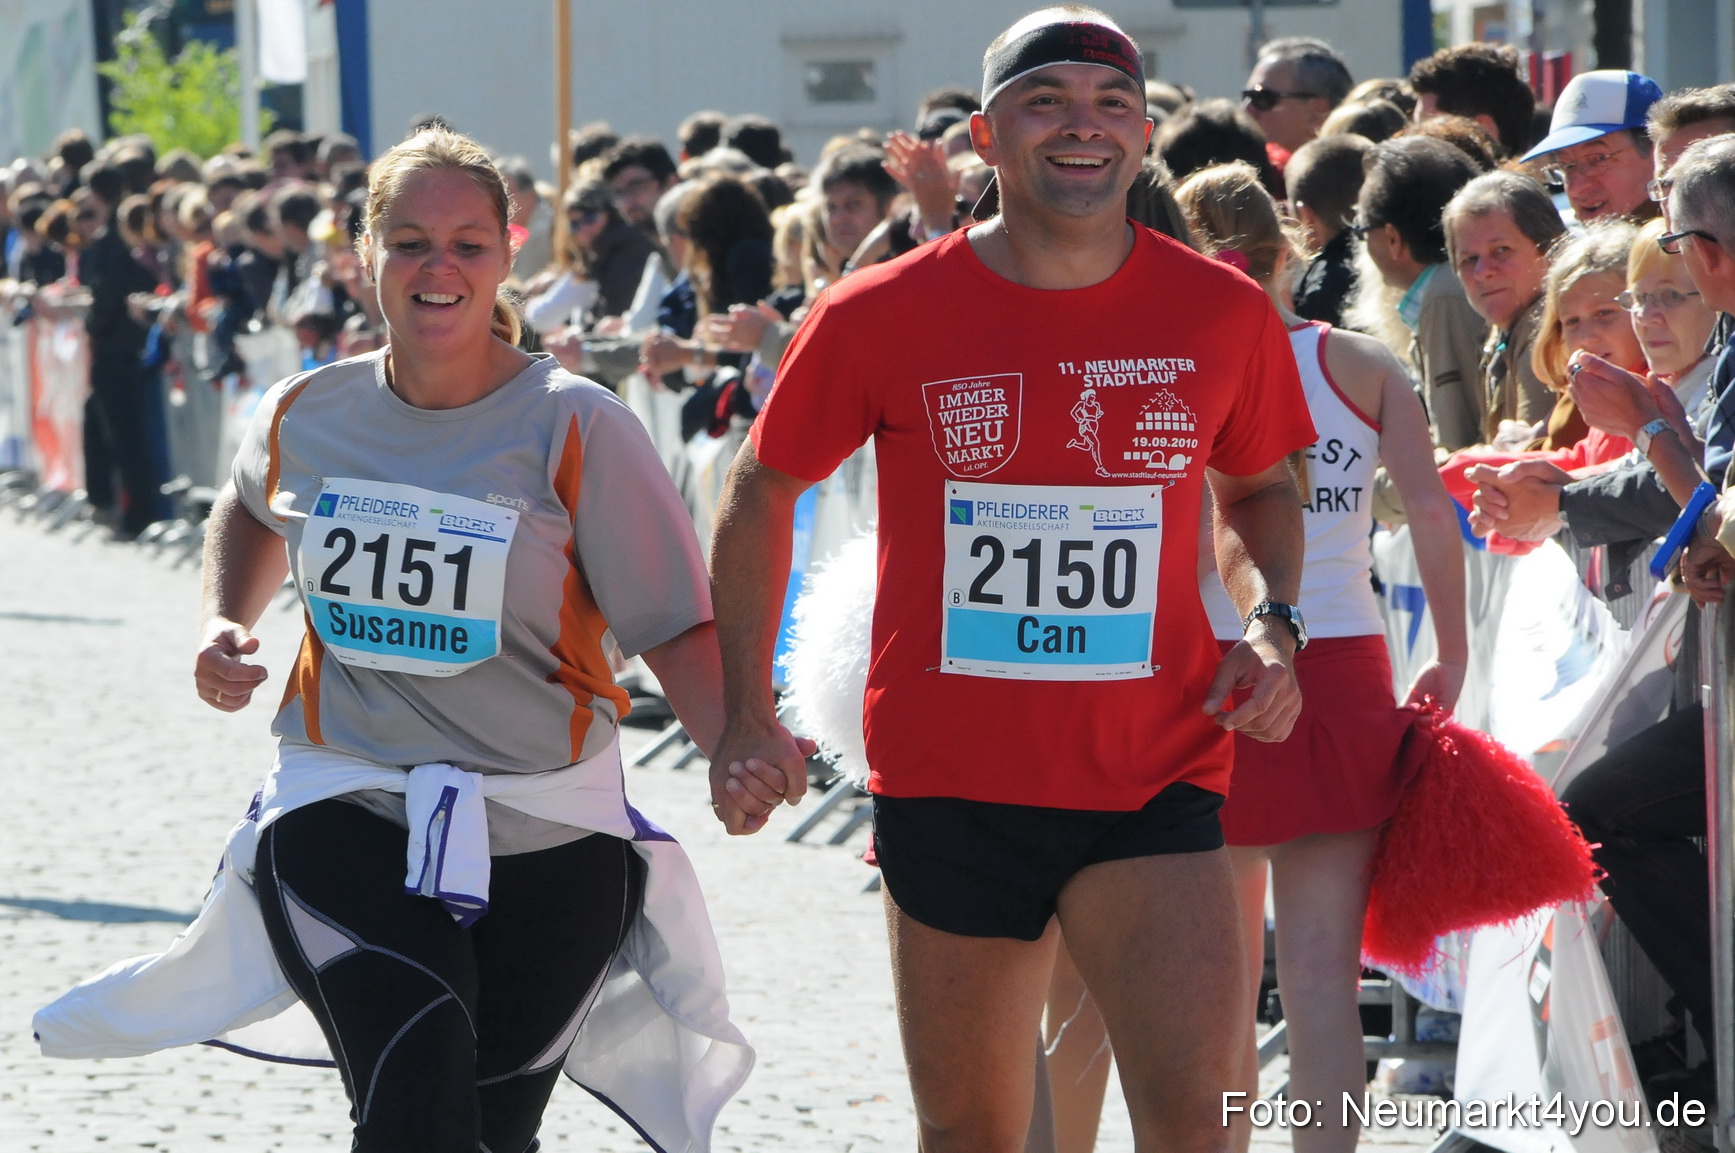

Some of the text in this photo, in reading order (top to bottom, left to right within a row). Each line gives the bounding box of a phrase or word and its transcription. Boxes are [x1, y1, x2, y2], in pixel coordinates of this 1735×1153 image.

[1058, 358, 1197, 375] 11. NEUMARKTER
[952, 380, 991, 391] 850 Jahre
[1083, 371, 1178, 388] STADTLAUF
[939, 388, 1006, 409] IMMER
[938, 404, 1010, 426] WIEDER
[943, 420, 1004, 448] NEU
[1132, 437, 1199, 449] 19.09.2010
[946, 444, 1005, 464] MARKT
[340, 495, 420, 520] PFLEIDERER
[977, 501, 1069, 520] PFLEIDERER
[1093, 508, 1145, 522] BOCK
[336, 512, 417, 529] AKTIENGESELLSCHAFT
[439, 514, 496, 533] BOCK
[976, 520, 1070, 531] AKTIENGESELLSCHAFT
[320, 527, 473, 611] 2151
[968, 535, 1138, 610] 2150
[953, 592, 960, 604] B
[328, 602, 468, 654] Susanne
[1017, 616, 1087, 654] Can
